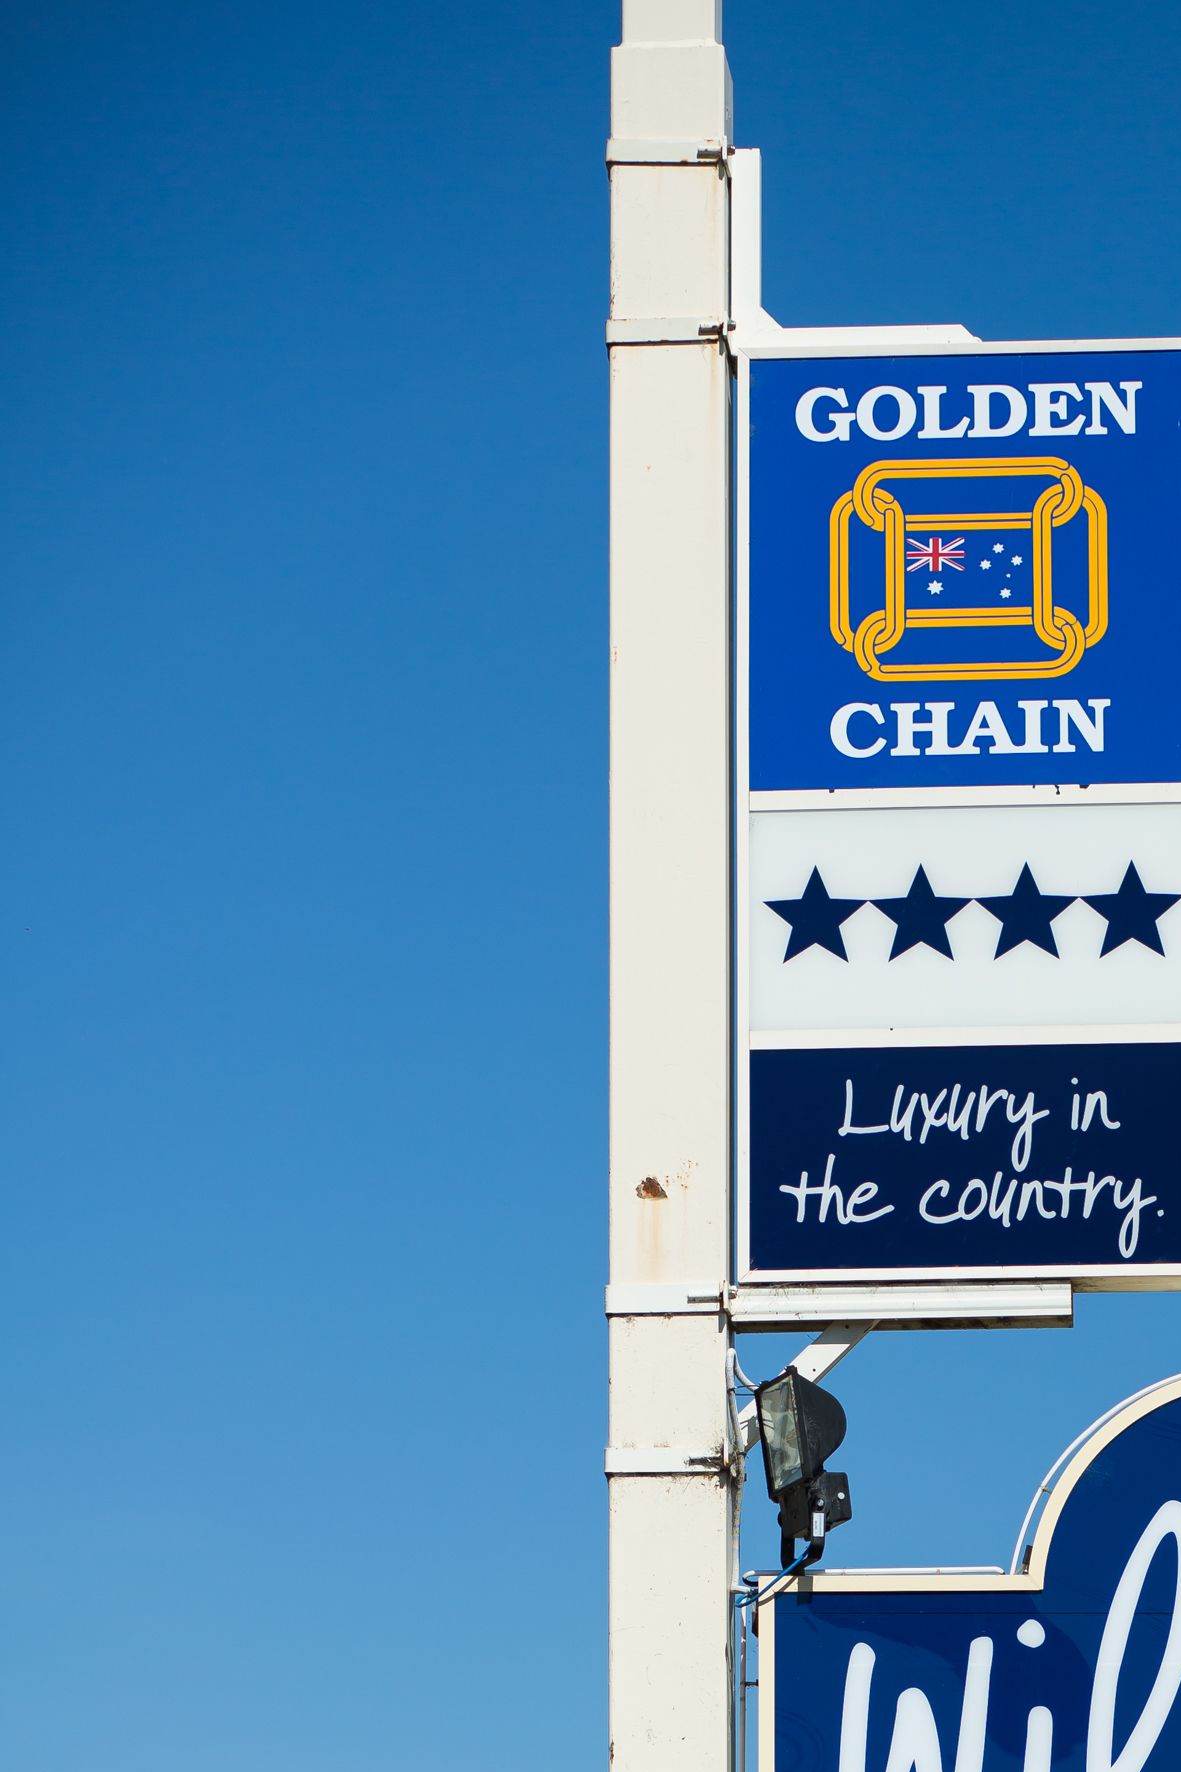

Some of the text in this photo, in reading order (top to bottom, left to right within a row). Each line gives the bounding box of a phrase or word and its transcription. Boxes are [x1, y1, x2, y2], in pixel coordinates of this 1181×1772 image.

[795, 381, 1143, 442] GOLDEN
[829, 698, 1111, 758] CHAIN
[838, 1077, 1121, 1172] Luxury in
[780, 1154, 1165, 1259] the country.
